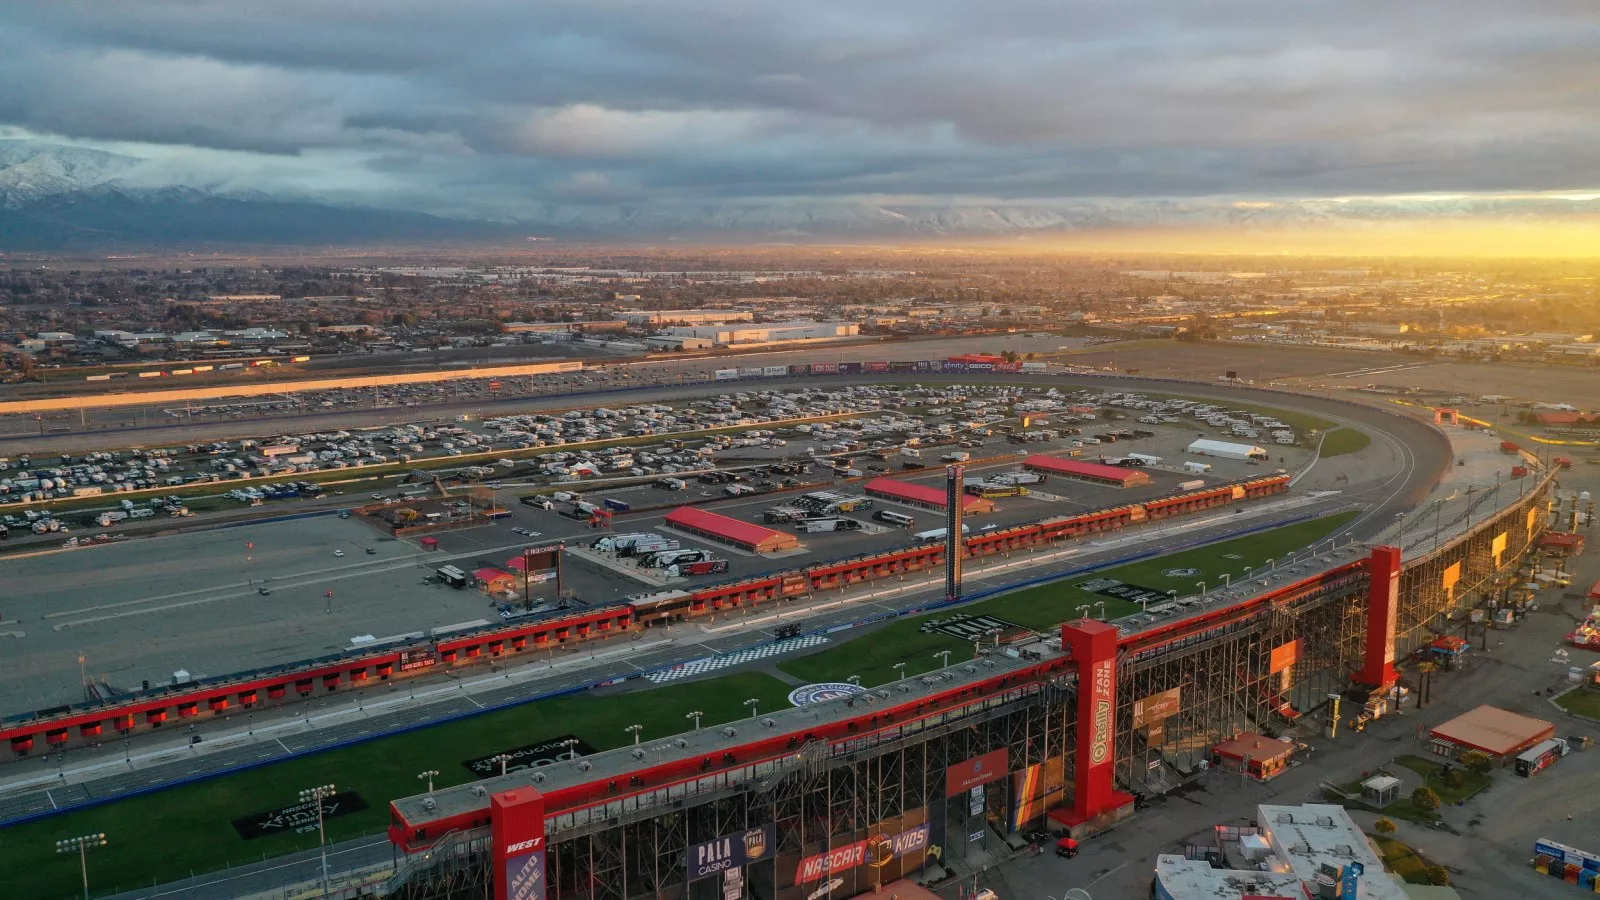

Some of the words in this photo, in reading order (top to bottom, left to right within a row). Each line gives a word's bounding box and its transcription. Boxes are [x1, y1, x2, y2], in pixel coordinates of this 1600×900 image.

[1096, 668, 1104, 694] FAN
[1103, 660, 1111, 697] ZONE
[1091, 700, 1110, 764] O'Reilly
[506, 837, 542, 854] WEST
[698, 838, 731, 866] PALA
[895, 827, 925, 853] KIDS
[511, 855, 538, 891] AUTO
[698, 859, 732, 876] CASINO
[803, 845, 863, 879] NASCAR
